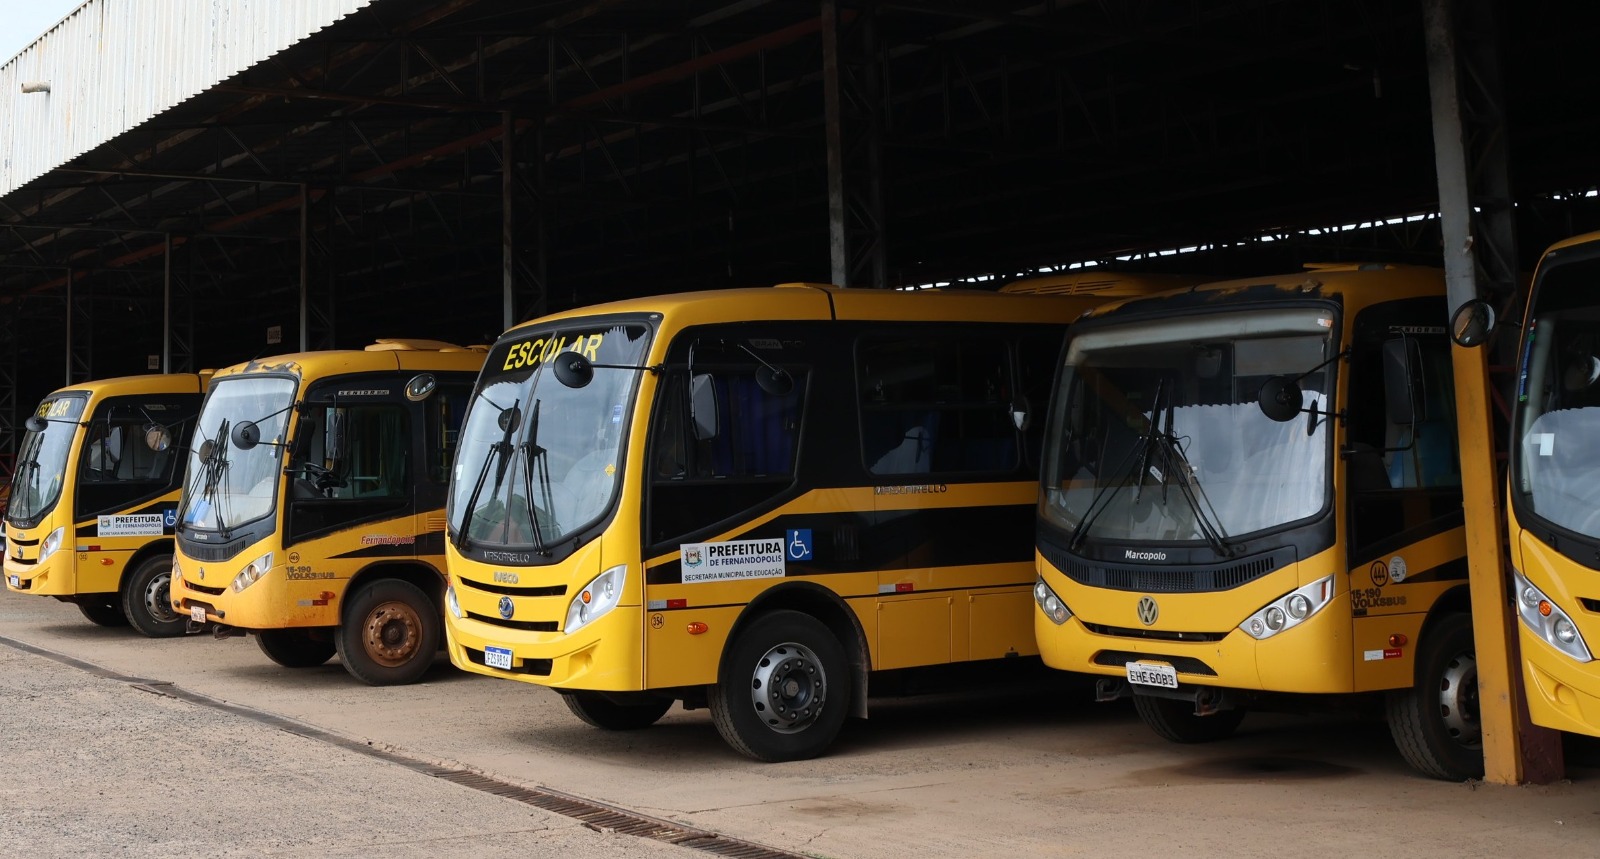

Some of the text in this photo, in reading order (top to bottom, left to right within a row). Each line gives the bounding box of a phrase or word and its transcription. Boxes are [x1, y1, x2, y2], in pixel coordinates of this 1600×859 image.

[874, 485, 947, 495] MASCARELLO
[115, 516, 161, 524] PREFEITURA
[709, 542, 781, 557] PREFEITURA
[1125, 550, 1166, 560] Marcopolo
[483, 551, 530, 563] MASCARELLO
[721, 555, 782, 566] FERNANDÓPOLIS
[494, 571, 519, 584] IVECO
[684, 573, 718, 581] SECRETARIA
[718, 571, 745, 579] MUNICIPAL
[754, 568, 782, 578] EDUCAÇÃO
[1374, 566, 1385, 581] 444
[1351, 589, 1381, 599] 15-190
[1352, 597, 1407, 608] VOLKSBUS
[653, 616, 663, 626] 354
